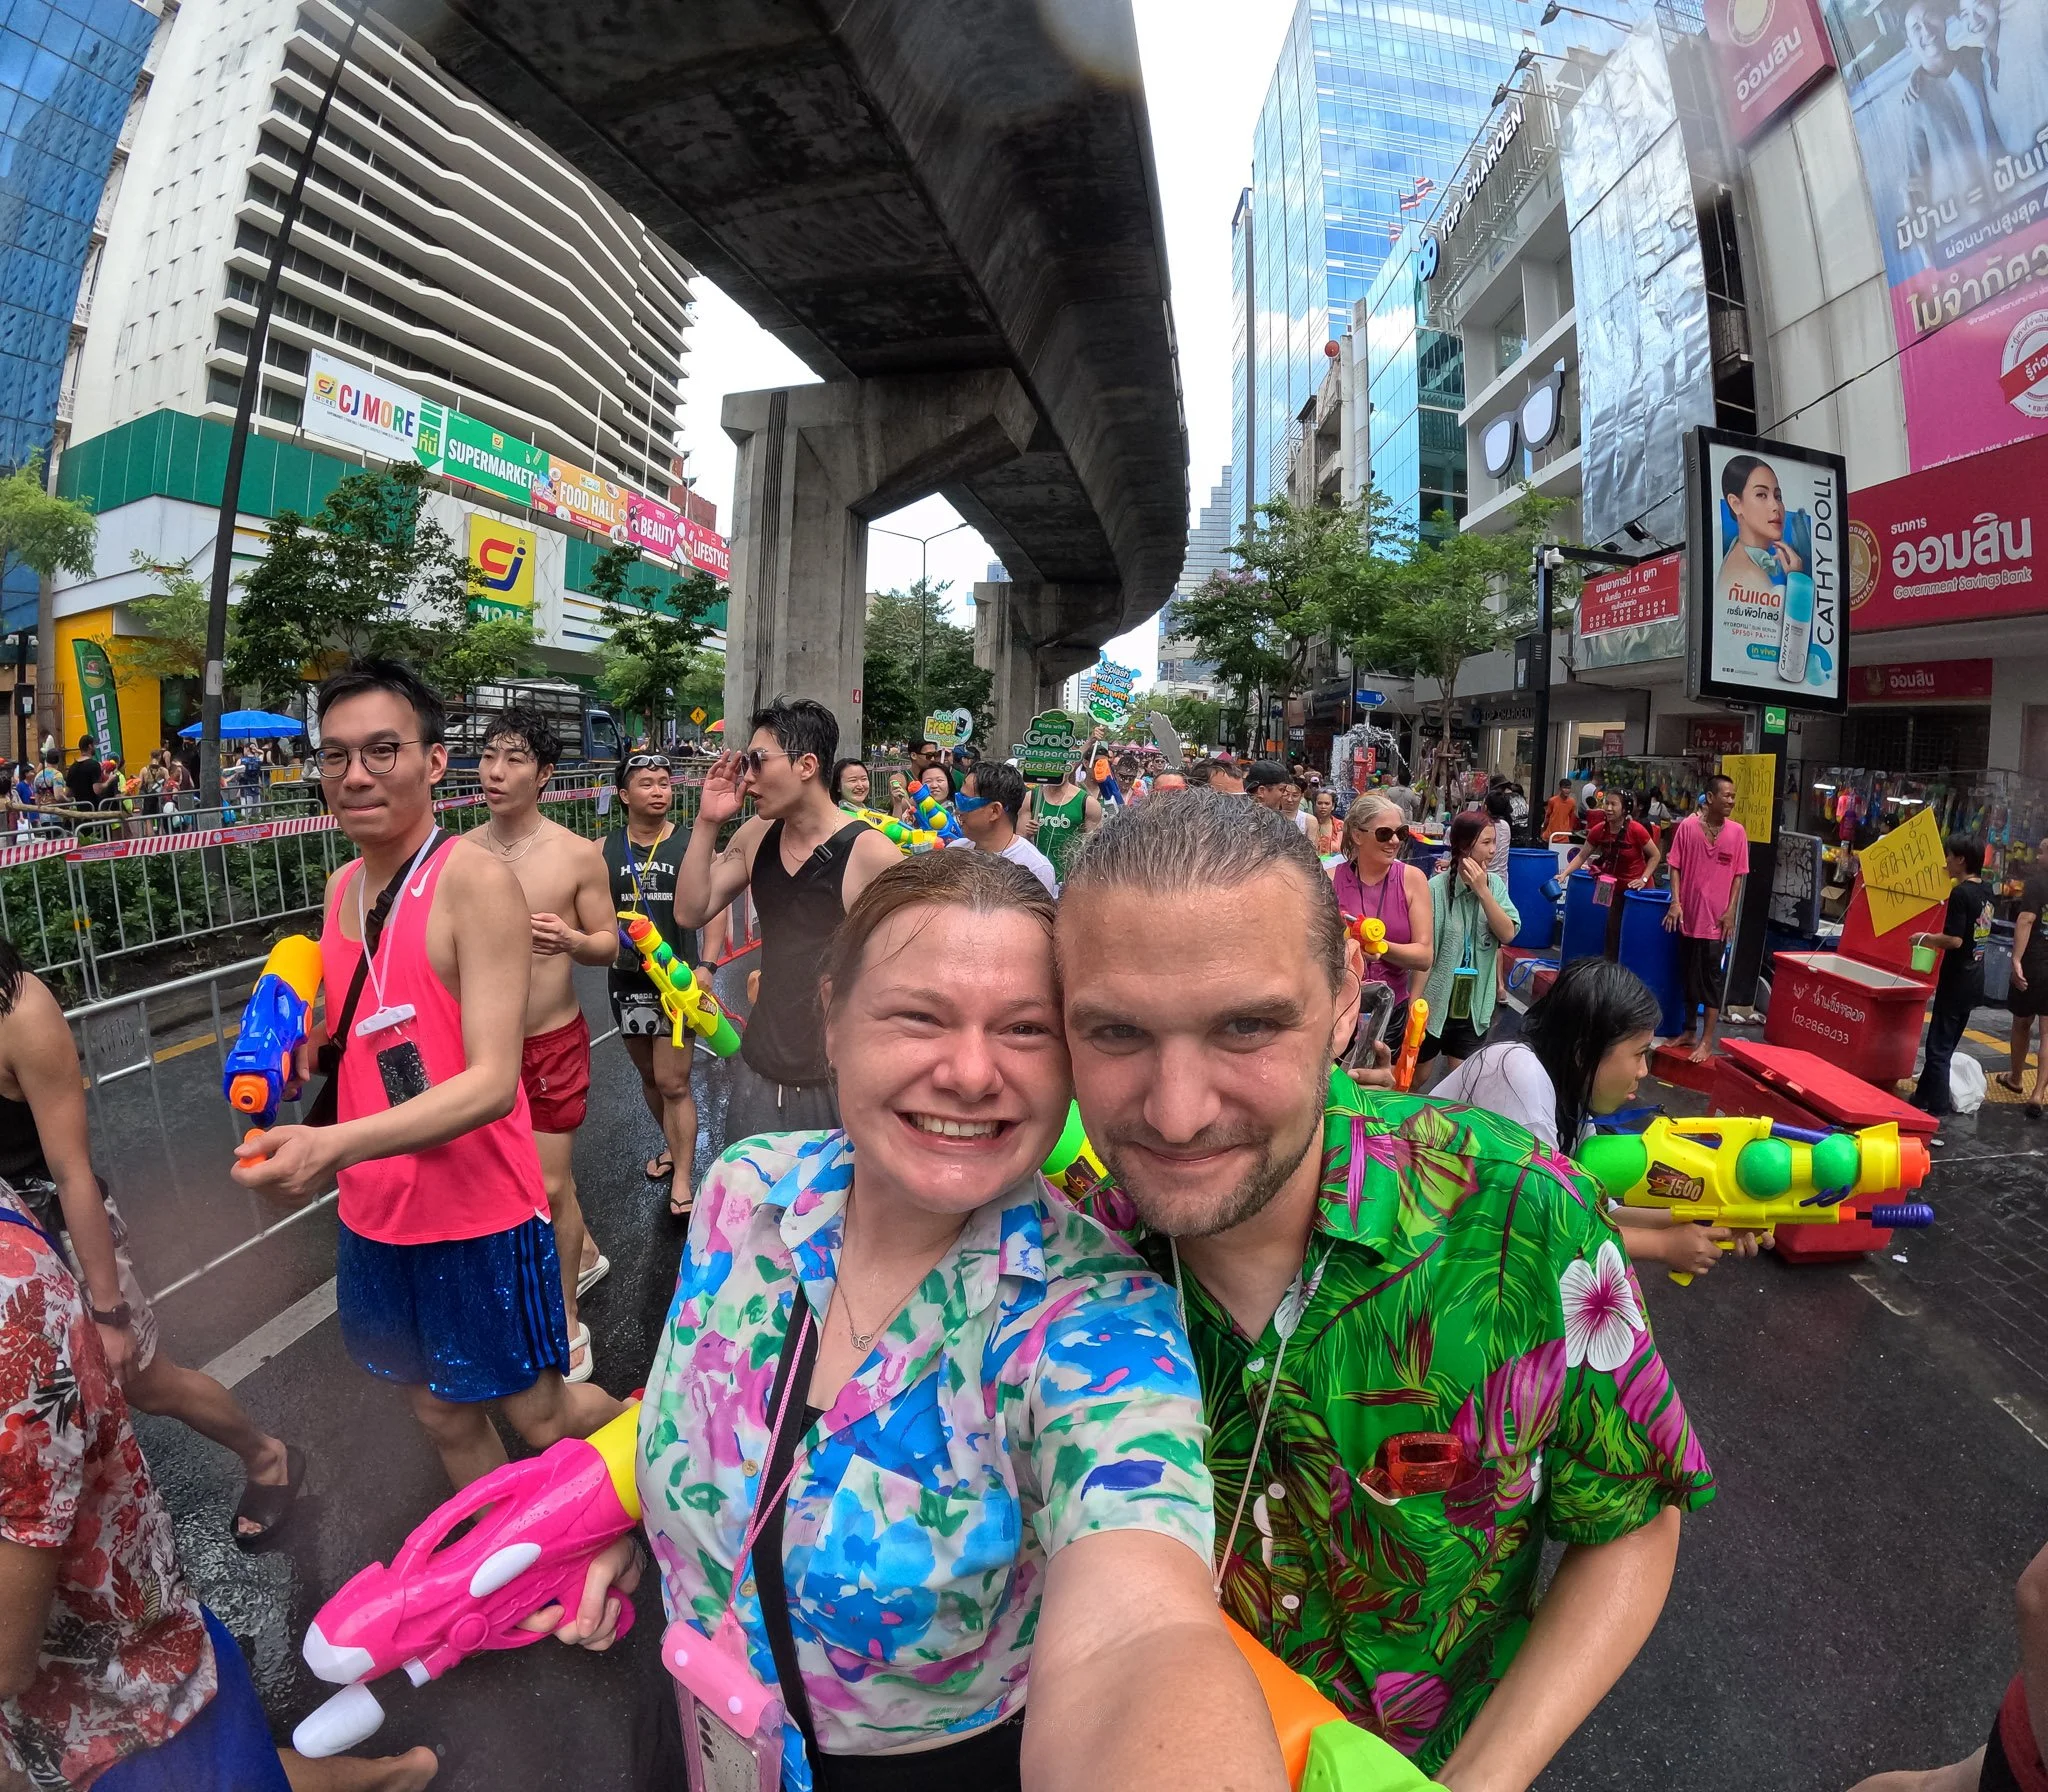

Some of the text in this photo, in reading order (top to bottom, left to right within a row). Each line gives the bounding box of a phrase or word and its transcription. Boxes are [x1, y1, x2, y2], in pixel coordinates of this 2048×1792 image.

[1736, 26, 1802, 101] ออมสิน
[1440, 103, 1526, 242] TOP CHAROEN
[1896, 199, 1958, 250] มีบ้าน
[339, 384, 360, 416] CJ
[362, 393, 415, 438] MORE
[448, 438, 536, 490] SUPERMARKET
[559, 480, 616, 523] FOOD HALL
[640, 515, 677, 548] BEAUTY
[1890, 517, 1928, 536] ธนาคาร
[693, 539, 729, 571] LIFESTYLE
[1891, 512, 2033, 579] ออมสิน
[1813, 476, 1835, 646] CATHY DOLL
[1635, 571, 1640, 582] 1
[1893, 565, 2033, 601] Government Savings Bank
[1728, 582, 1781, 608] กันแดด
[1759, 647, 1777, 656] vivo
[1096, 672, 1133, 690] with Care
[1103, 663, 1130, 678] Splash
[1889, 669, 1935, 688] ออมสิน
[1087, 691, 1128, 715] GrabCar
[1090, 682, 1130, 702] Ride with
[926, 718, 957, 736] Free!
[936, 711, 953, 721] Grab
[1025, 729, 1074, 748] Grab
[1014, 746, 1080, 760] Transparent
[1019, 760, 1072, 773] Fare Price
[645, 892, 673, 901] WARRIORS
[1665, 1178, 1702, 1200] 1500
